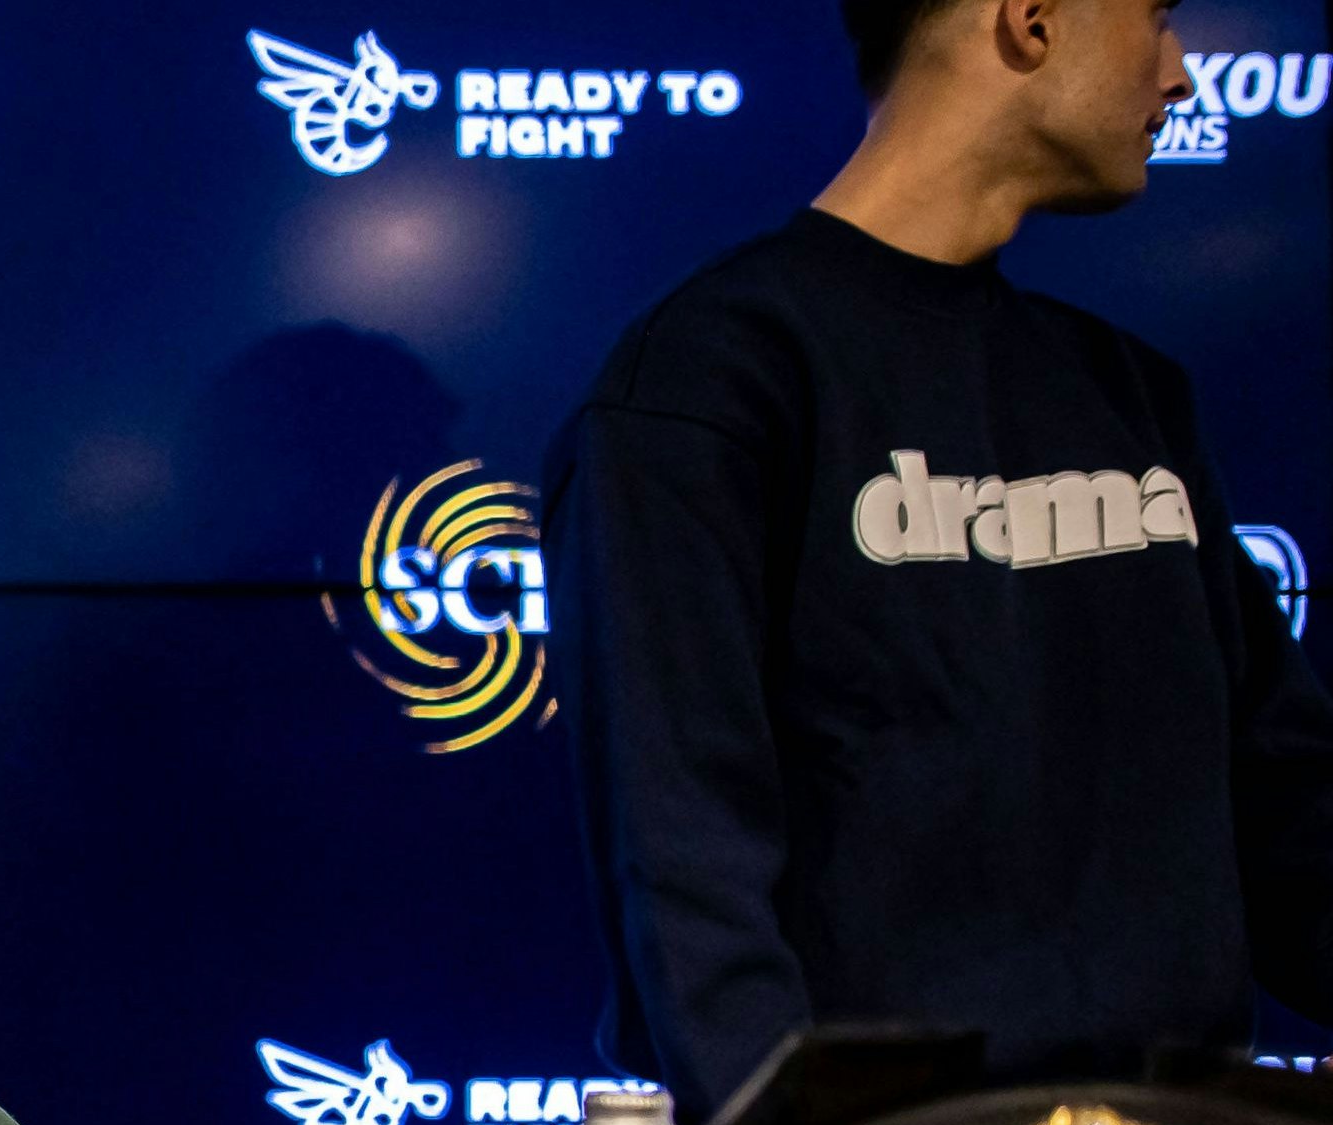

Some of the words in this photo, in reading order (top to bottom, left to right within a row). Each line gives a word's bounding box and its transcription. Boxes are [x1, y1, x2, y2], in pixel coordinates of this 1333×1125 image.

[455, 68, 651, 114] READY
[657, 70, 744, 116] TO
[455, 114, 624, 159] FIGHT
[852, 448, 1200, 570] drama
[465, 1077, 663, 1123] REA
